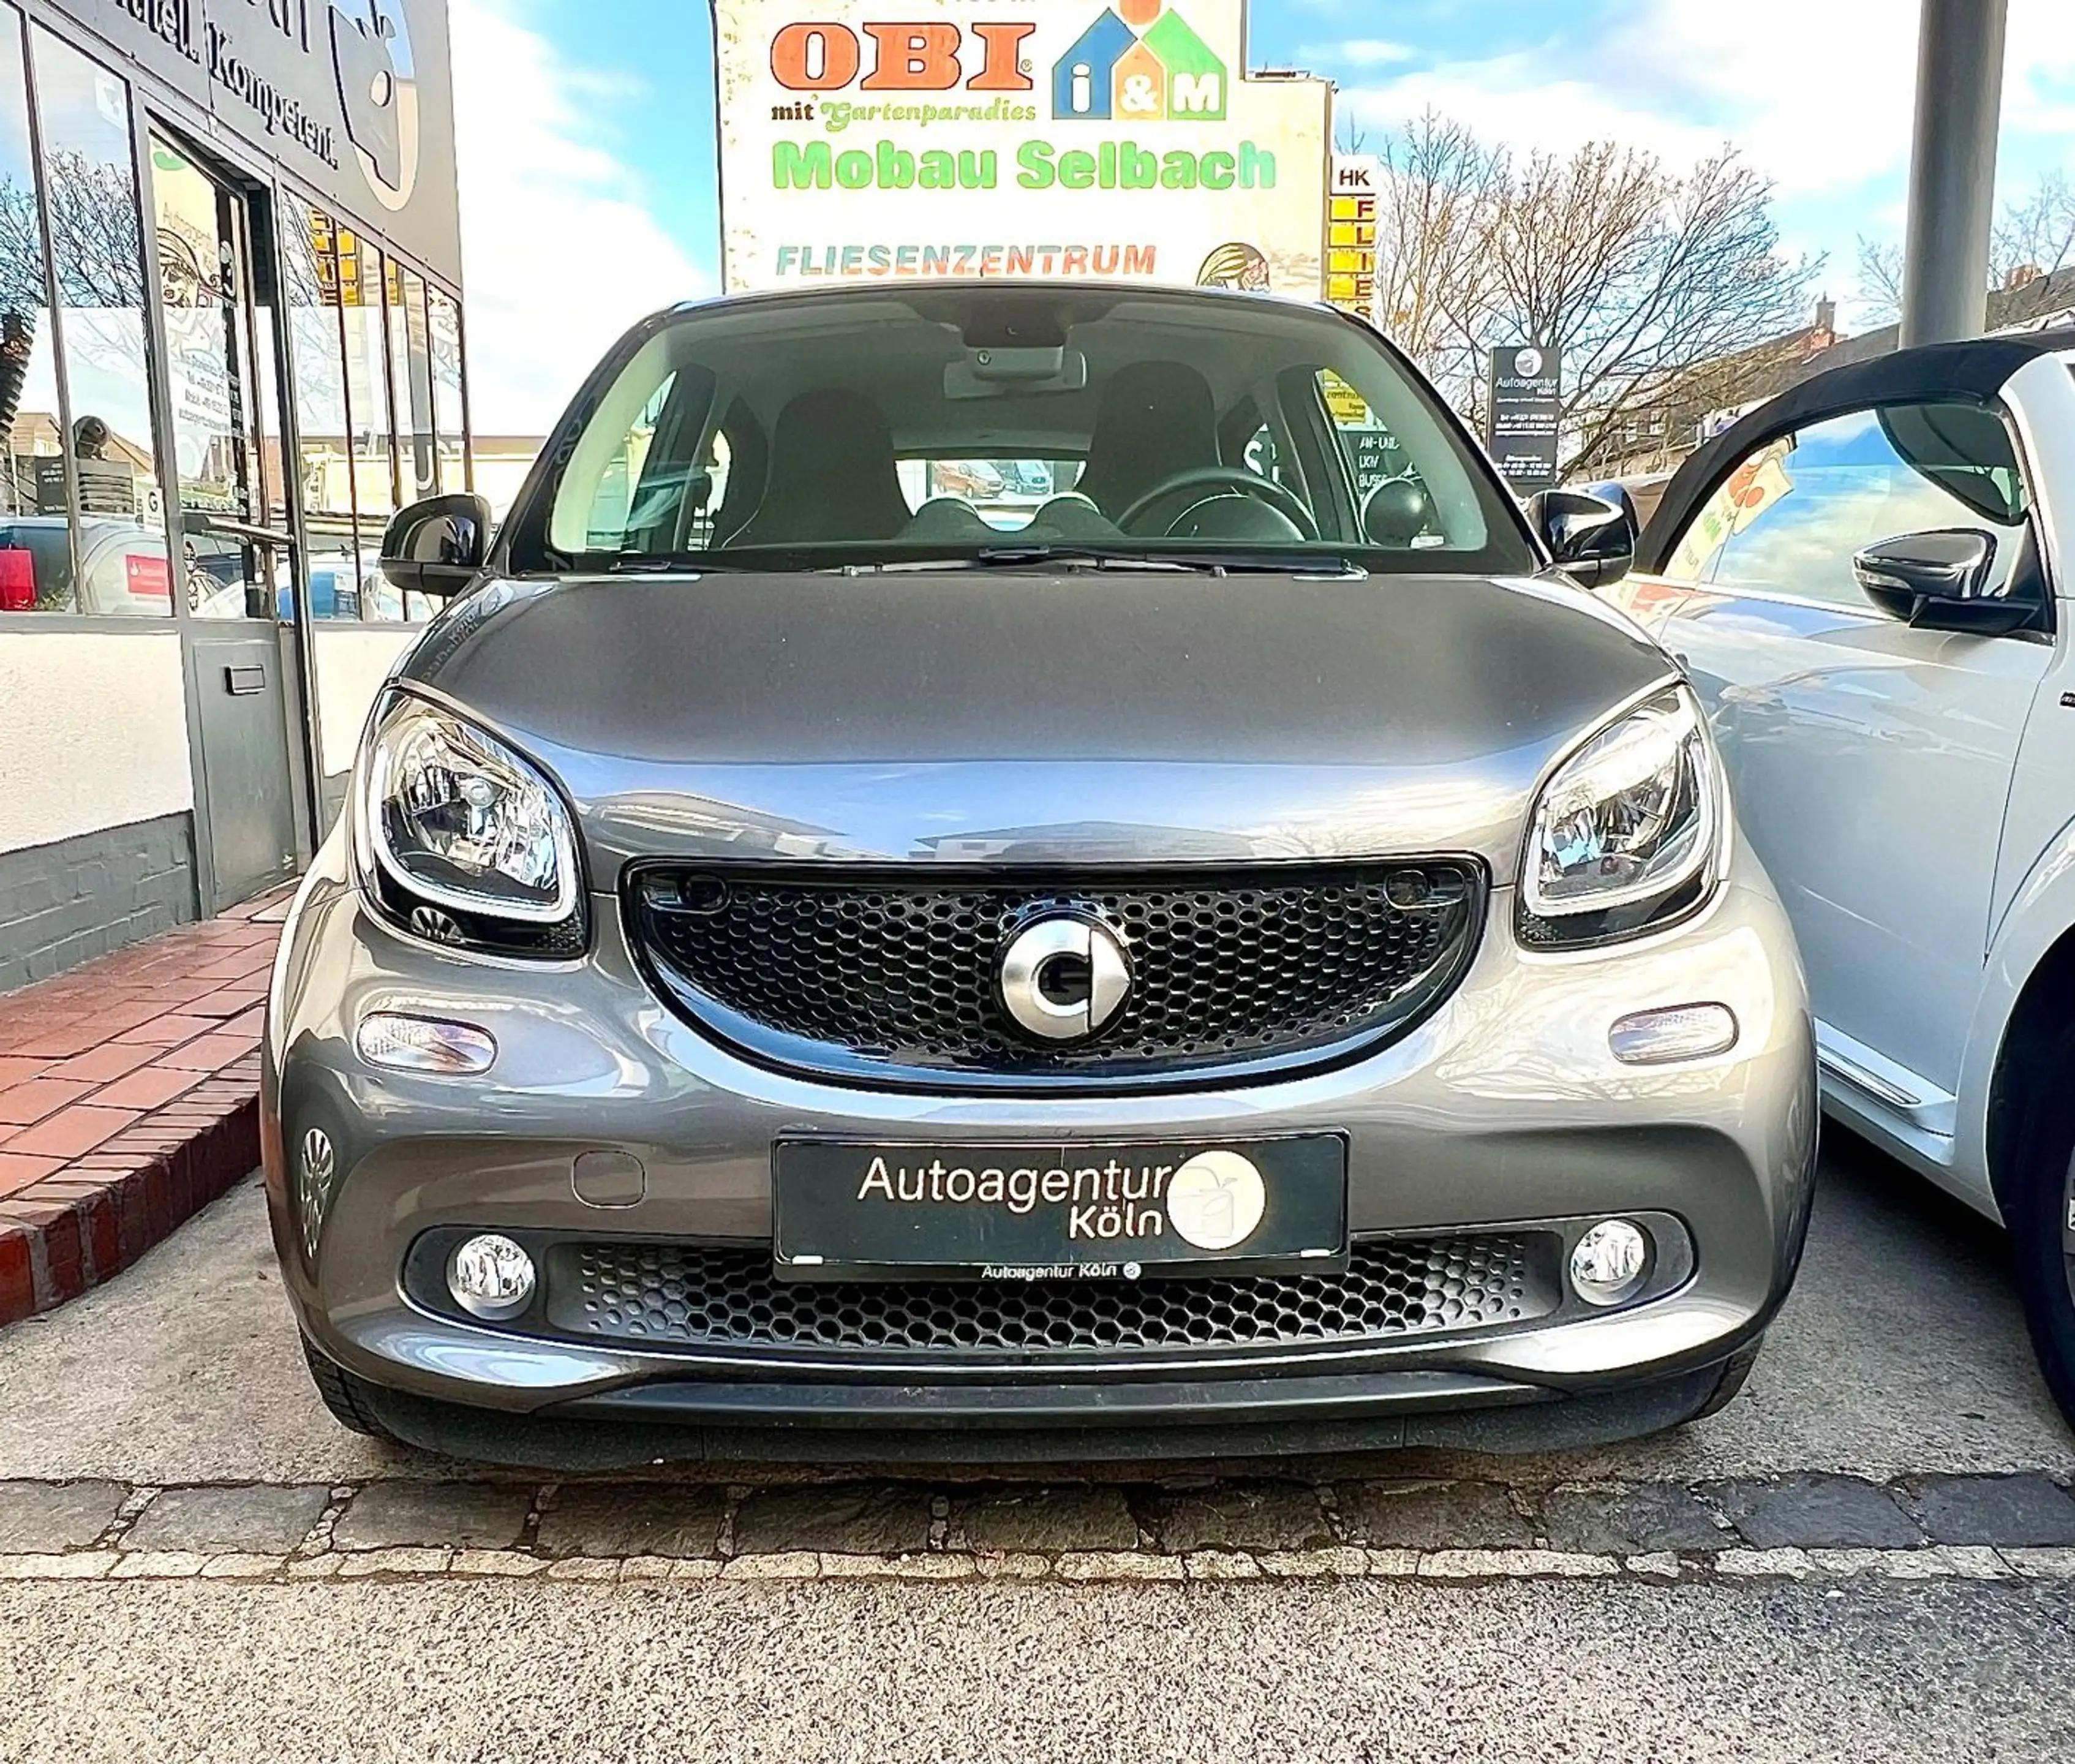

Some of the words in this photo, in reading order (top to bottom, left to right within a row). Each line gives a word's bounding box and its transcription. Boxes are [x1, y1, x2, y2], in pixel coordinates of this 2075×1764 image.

[770, 22, 1037, 91] OBI
[771, 101, 815, 121] mit
[819, 97, 1036, 132] Gartenparadies
[772, 140, 997, 189] Mobau
[1017, 140, 1276, 189] Selbach
[1339, 169, 1370, 186] HK
[776, 244, 1158, 276] FLIESENZENTRUM
[1496, 377, 1558, 390] Autoagentur
[857, 1155, 1172, 1213] Autoagentur
[1069, 1202, 1164, 1239] Köln
[982, 1265, 1075, 1281] Autoagentur
[1079, 1262, 1117, 1278] Köln
